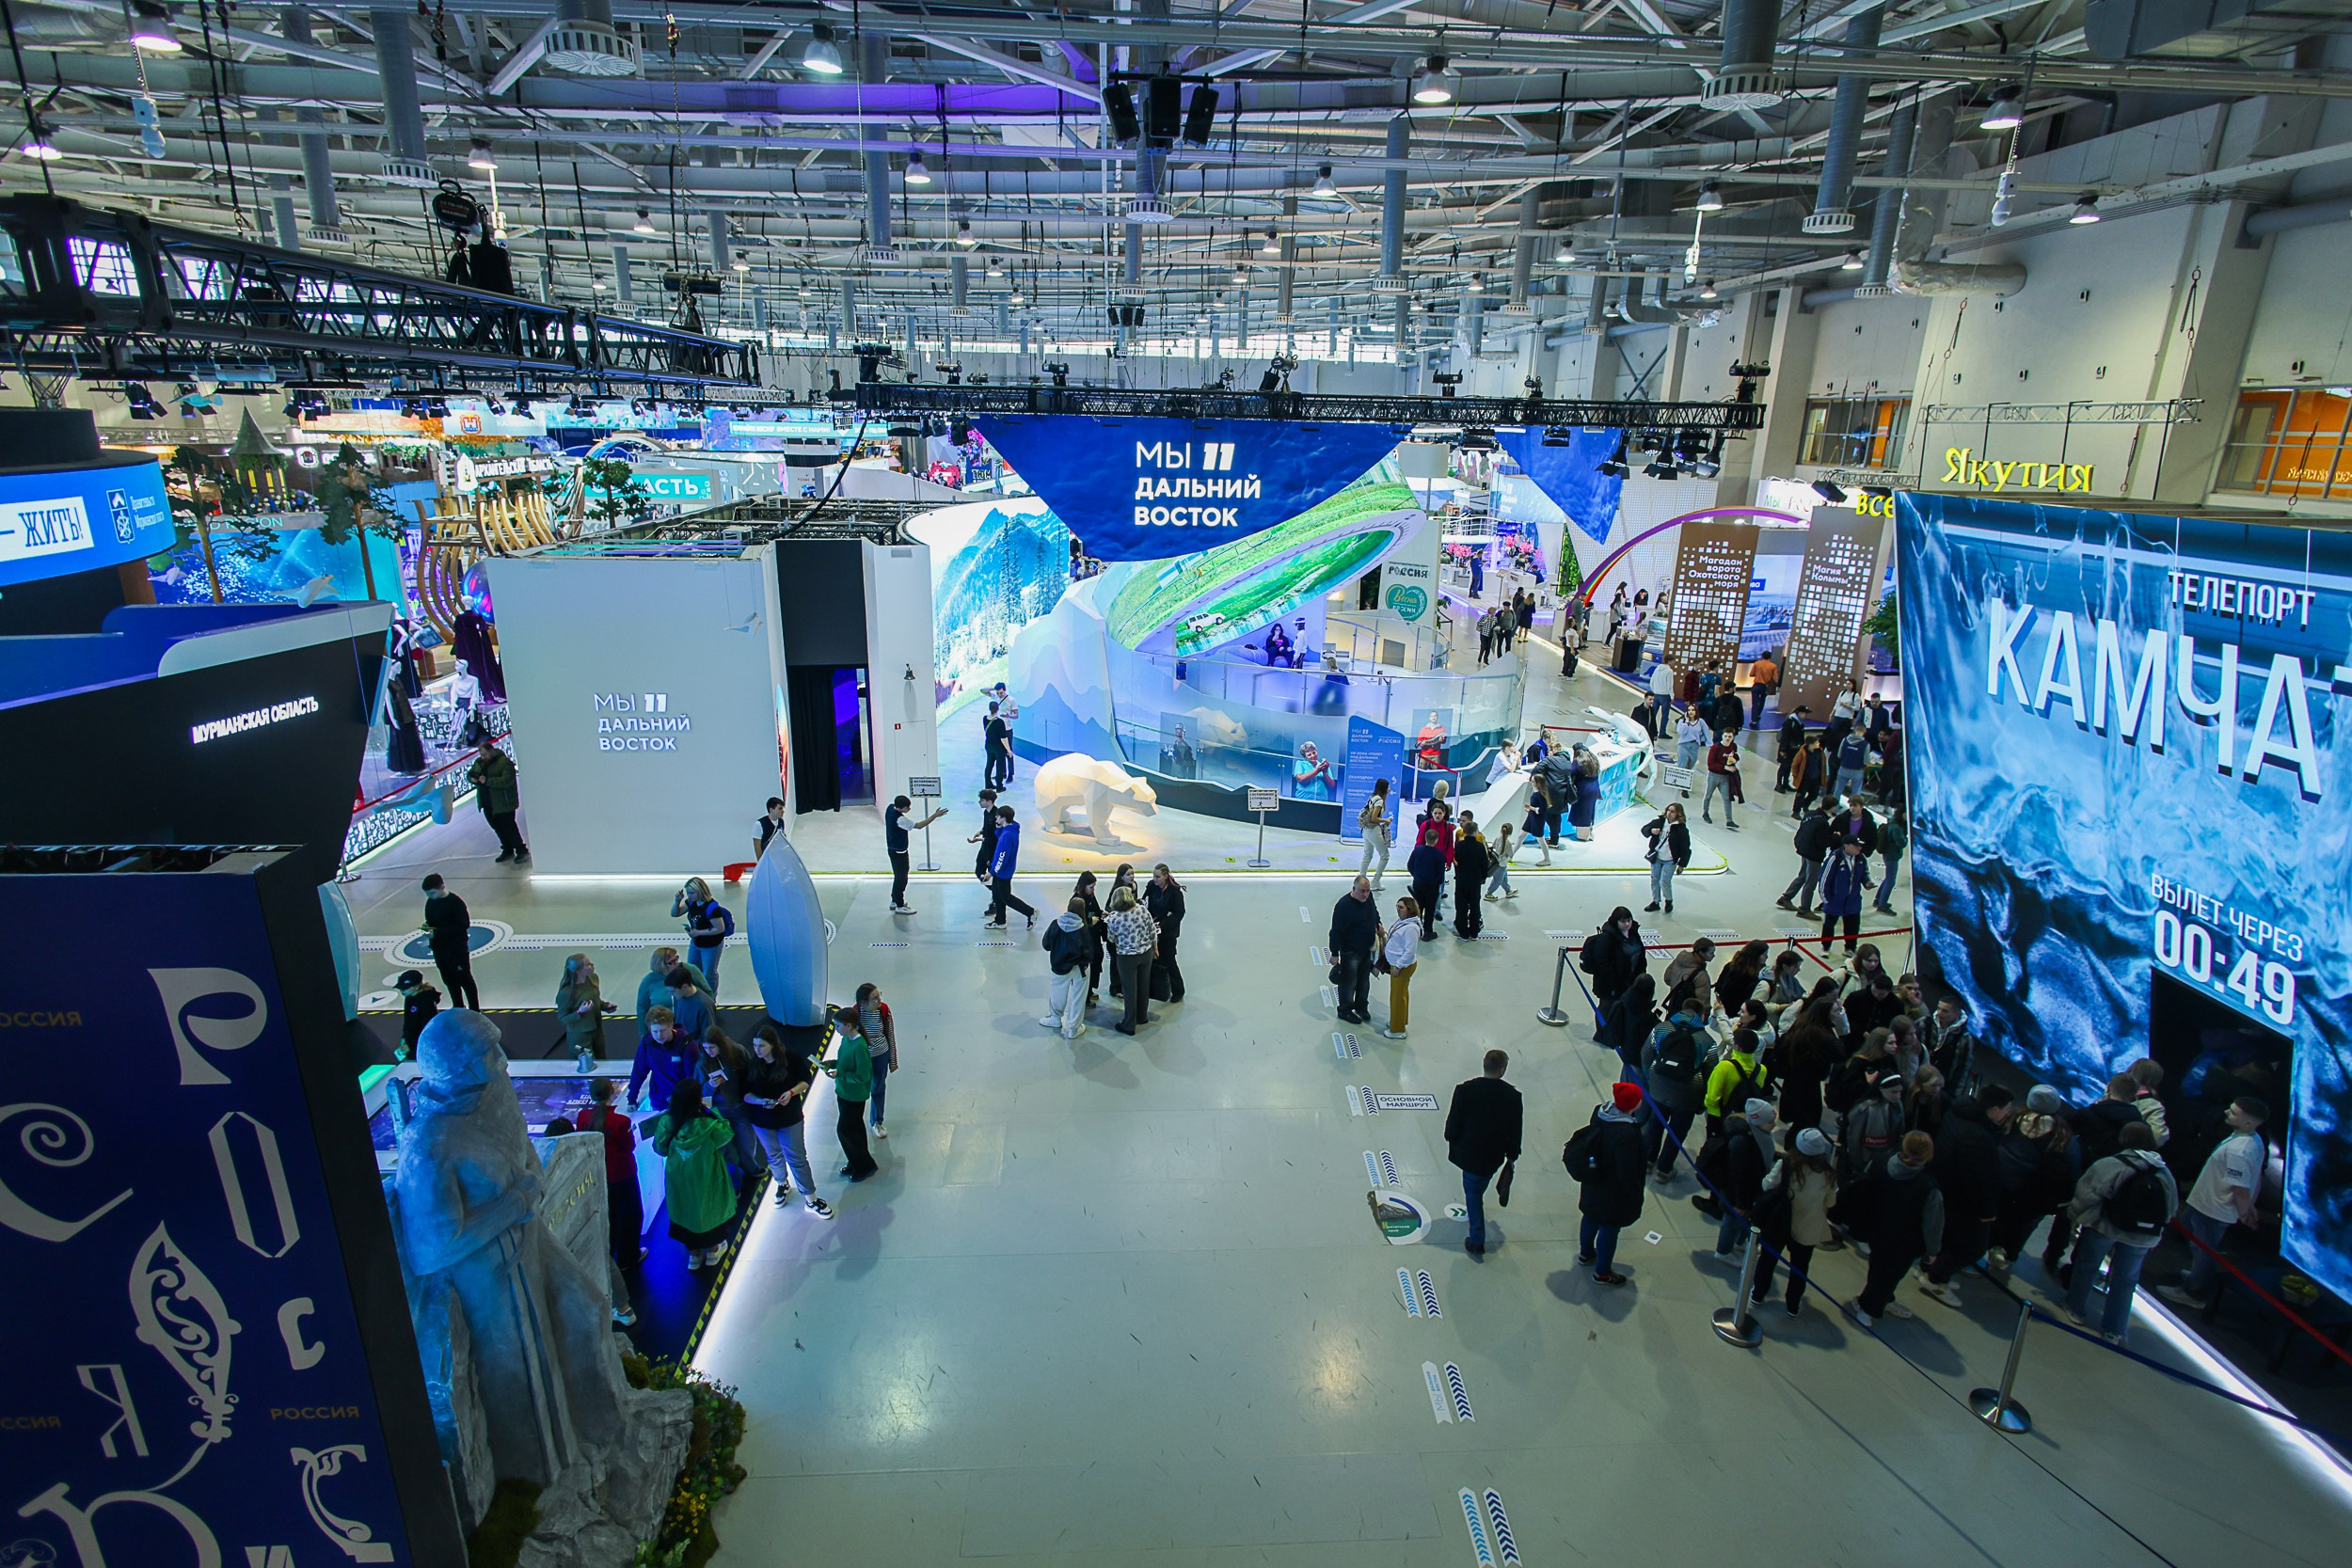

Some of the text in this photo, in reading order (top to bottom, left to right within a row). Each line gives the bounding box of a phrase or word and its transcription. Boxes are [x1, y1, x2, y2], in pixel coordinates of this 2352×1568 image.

[1136, 441, 1191, 469] МЫ
[1940, 447, 2096, 493] Якутия
[1135, 474, 1262, 500] ДАЛЬНИЙ
[18, 506, 84, 547] ЖИТЬ!
[1135, 506, 1239, 528] ВОСТОК
[1698, 555, 1742, 566] Магадан
[1706, 565, 1741, 574] ворота
[1812, 563, 1841, 577] Магия
[1388, 565, 1429, 578] РОССИЯ
[1688, 569, 1740, 580] Охотского
[1810, 572, 1849, 585] Колымы
[1387, 584, 1418, 604] Весна
[1714, 580, 1739, 589] моря
[2168, 571, 2316, 631] ТЕЛЕПОРТ
[594, 693, 636, 712] МЫ
[192, 696, 319, 744] МУРМАНСКАЯ ОБЛАСТЬ
[597, 713, 691, 734] ДАЛЬНИЙ
[598, 736, 676, 751] ВОСТОК
[2152, 873, 2304, 962] ВЫЛЕТ ЧЕРЕЗ
[2153, 910, 2296, 1025] 00:49
[270, 1405, 360, 1420] РОССИЯ
